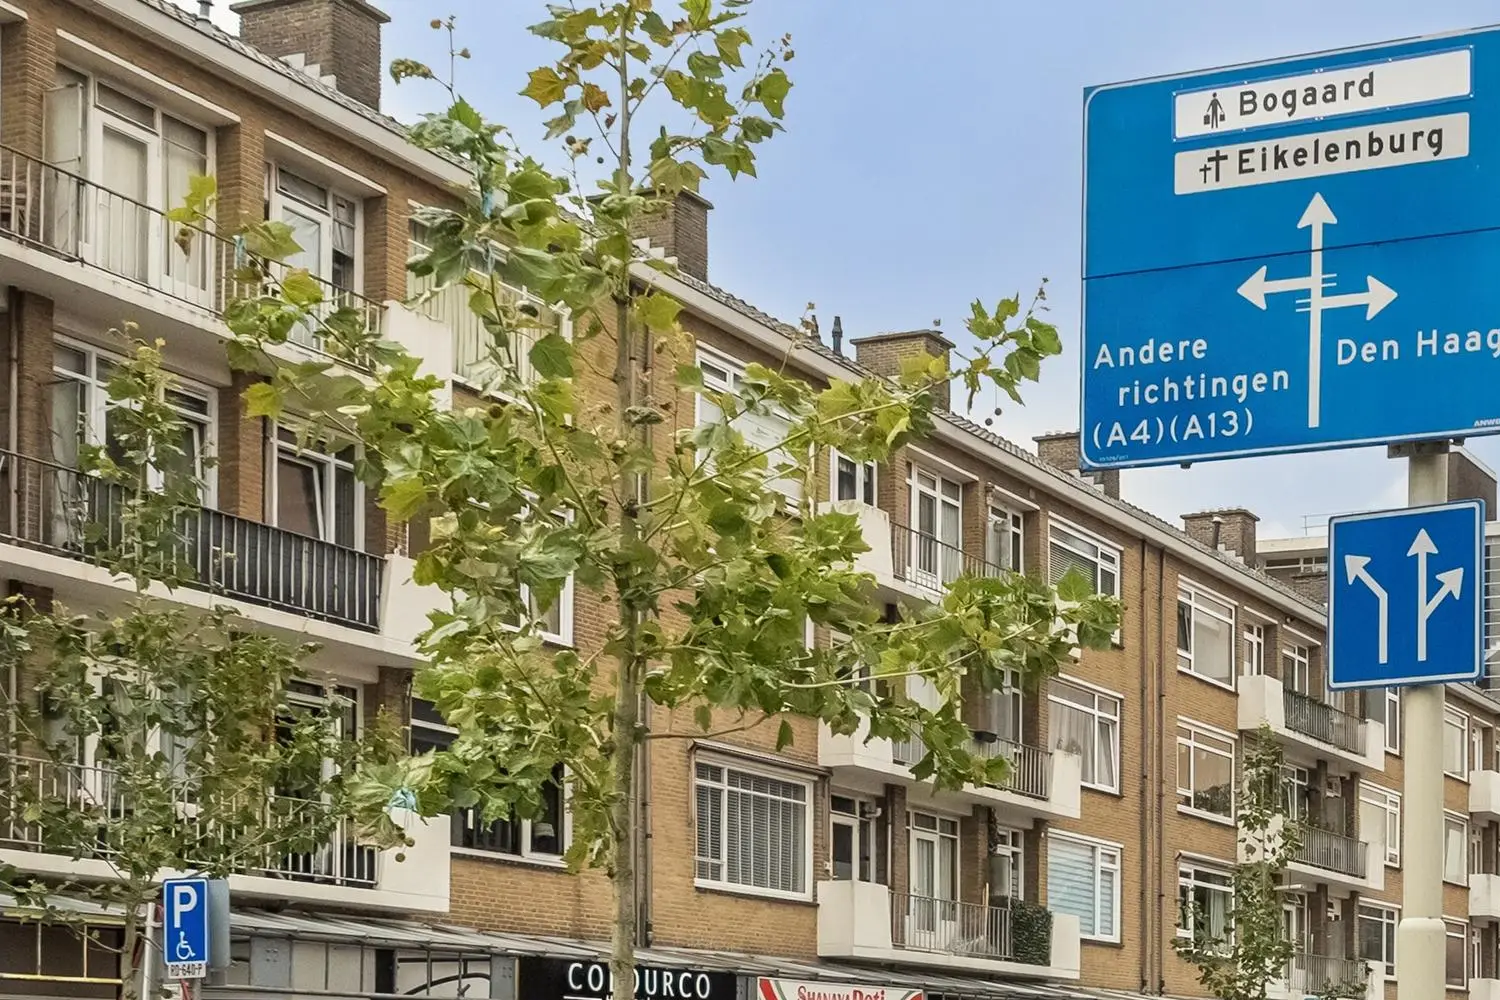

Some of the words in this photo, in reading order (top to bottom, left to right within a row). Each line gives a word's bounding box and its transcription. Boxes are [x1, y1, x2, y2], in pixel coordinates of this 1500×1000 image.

[1238, 71, 1376, 117] Bogaard
[1237, 125, 1444, 175] Eikelenburg
[1094, 337, 1208, 369] Andere
[1337, 336, 1399, 366] Den
[1118, 370, 1289, 407] richtingen
[173, 885, 198, 928] P
